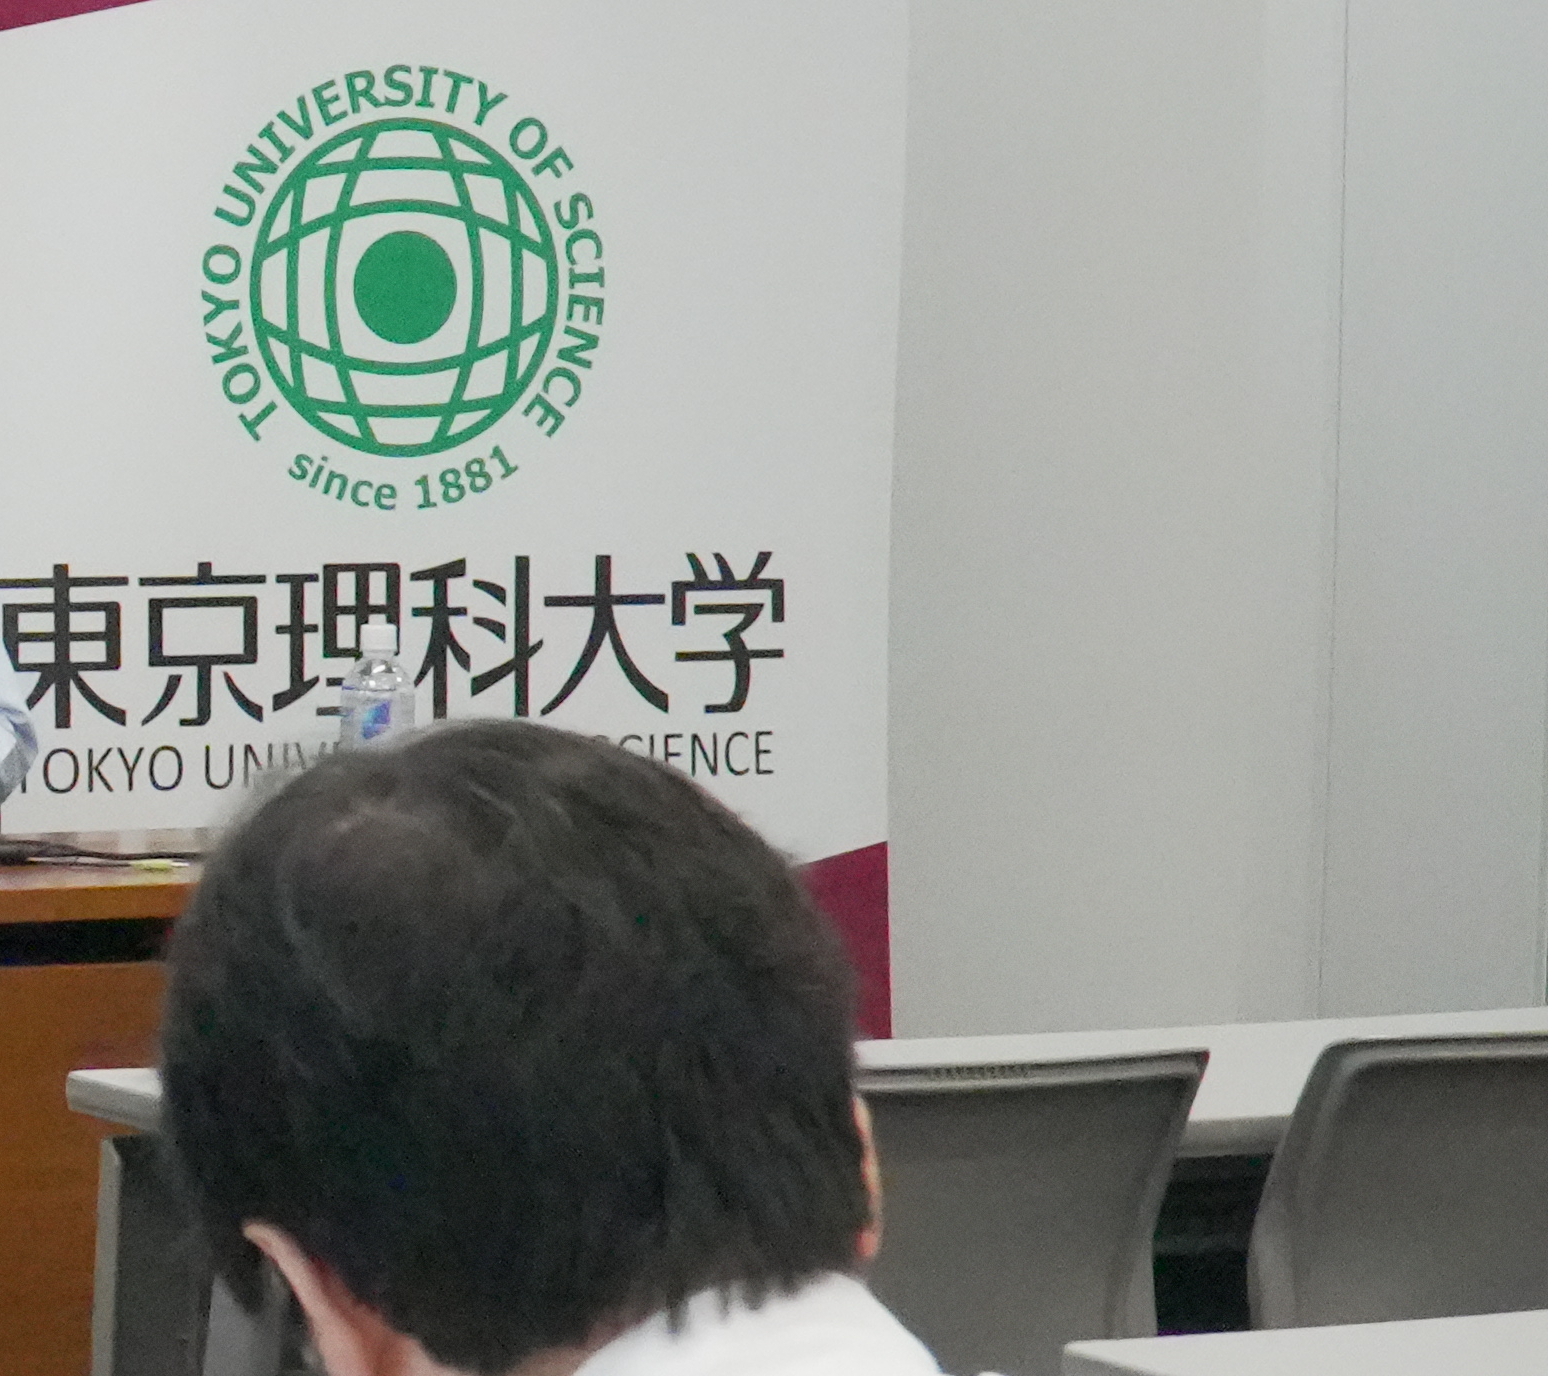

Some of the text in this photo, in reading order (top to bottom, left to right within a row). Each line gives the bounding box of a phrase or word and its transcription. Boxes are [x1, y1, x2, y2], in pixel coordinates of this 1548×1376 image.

[201, 64, 605, 441] TOKYO UNIVERSITY OF SCIENCE
[288, 444, 518, 510] since 1881
[593, 730, 774, 777] IENCE
